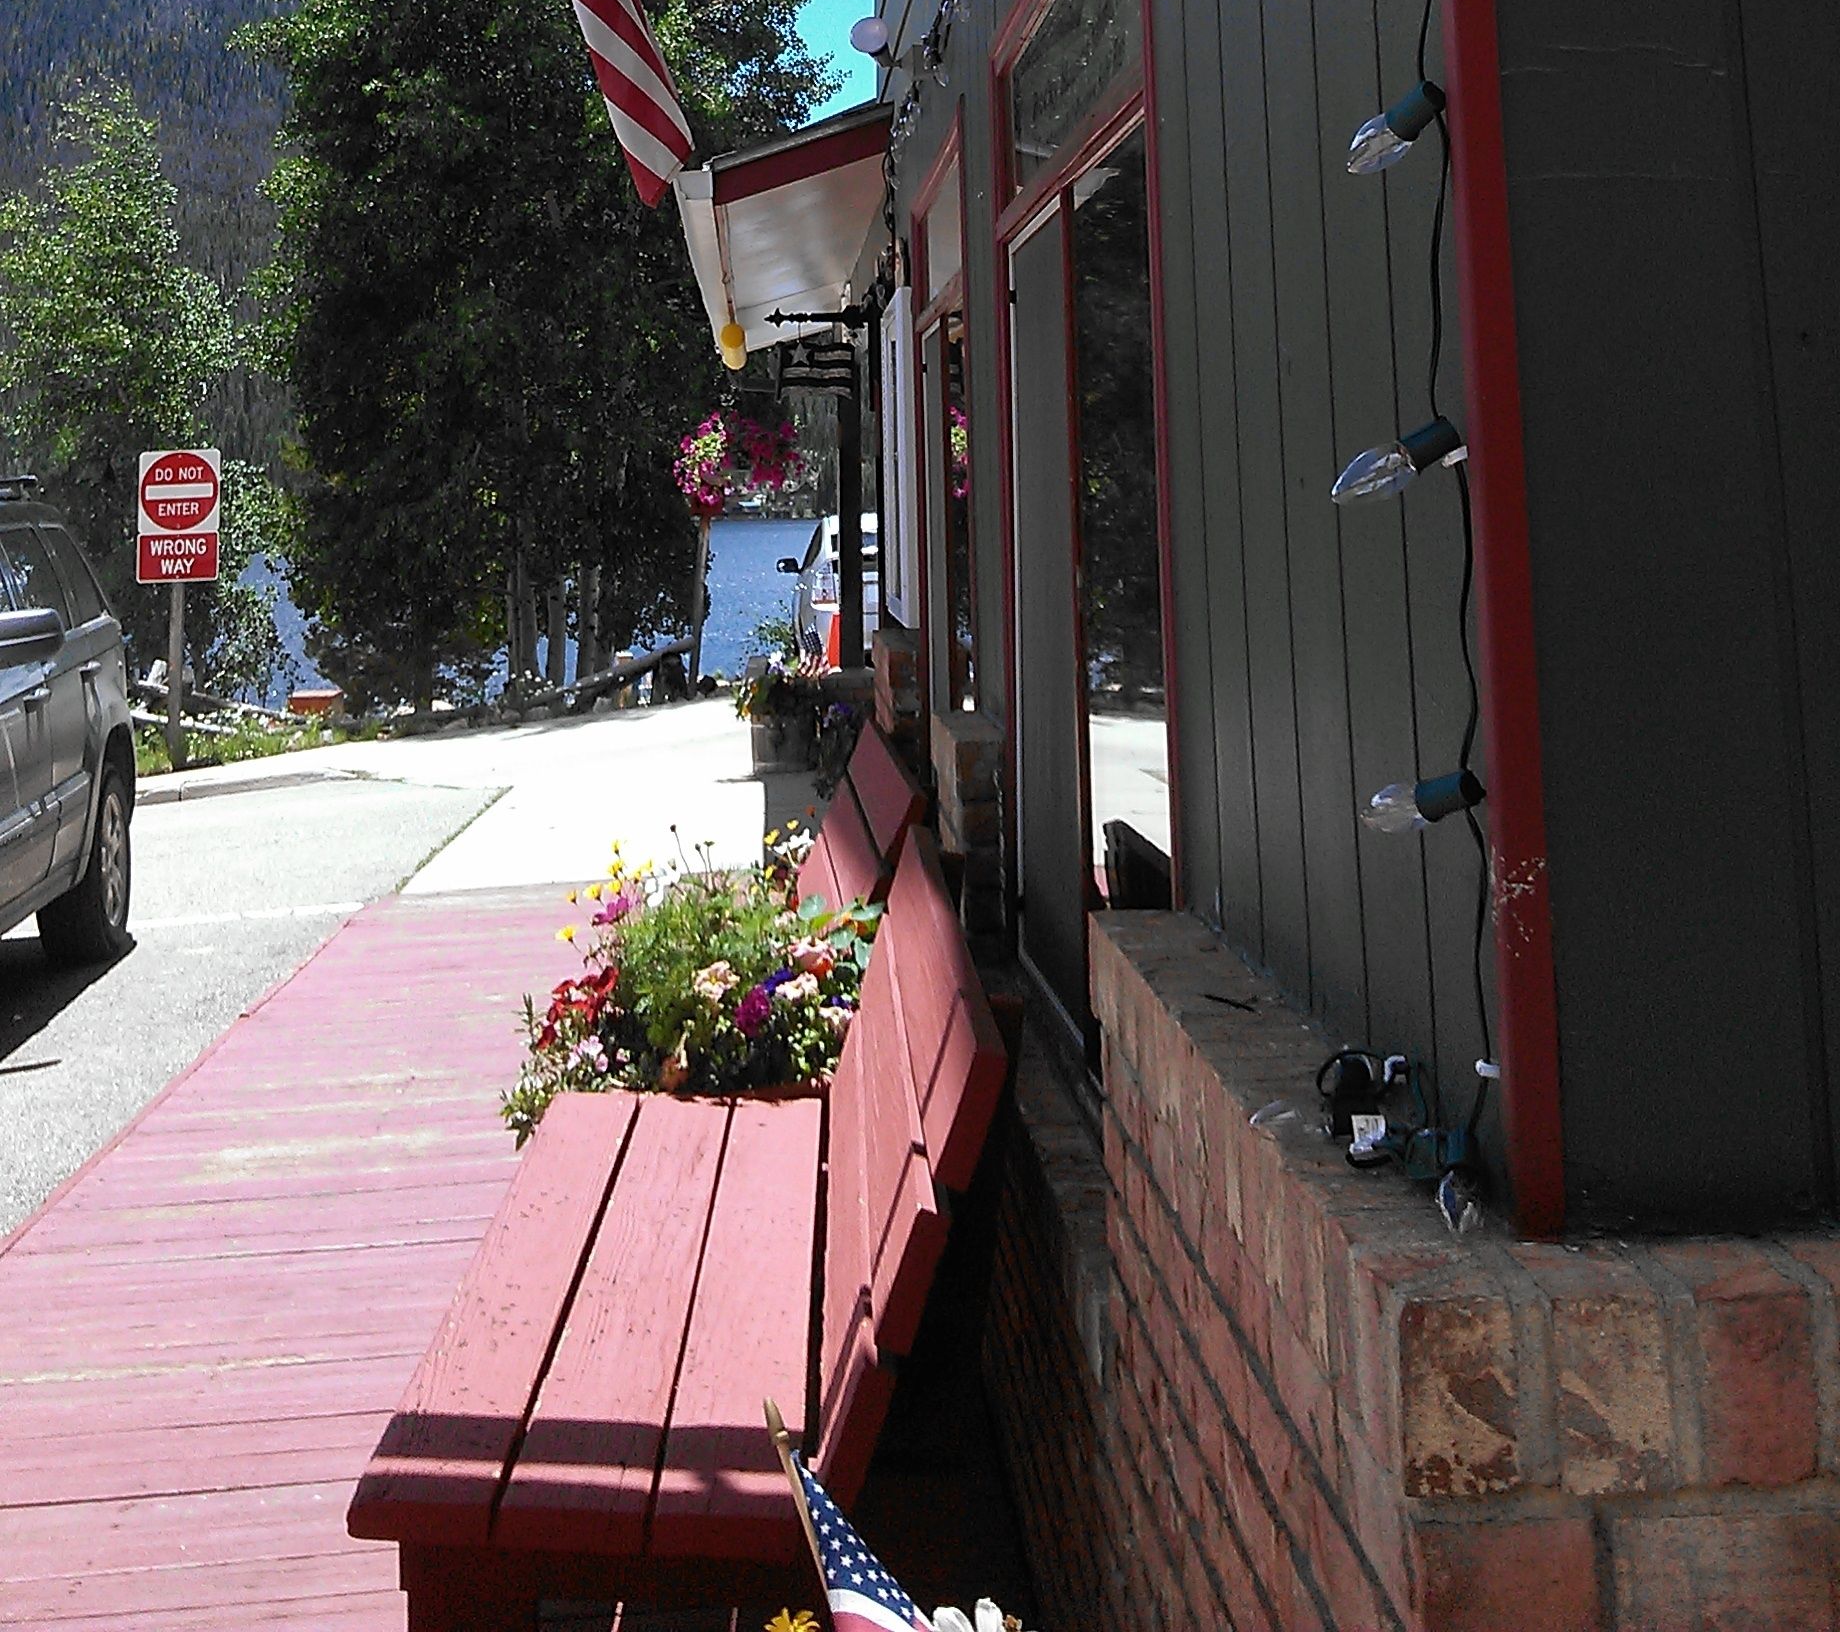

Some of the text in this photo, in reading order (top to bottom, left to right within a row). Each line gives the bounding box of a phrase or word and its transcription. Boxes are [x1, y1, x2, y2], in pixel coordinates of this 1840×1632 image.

[155, 466, 204, 481] DO NOT
[158, 502, 199, 517] ENTER
[150, 538, 207, 556] WRONG
[160, 558, 195, 575] WAY
